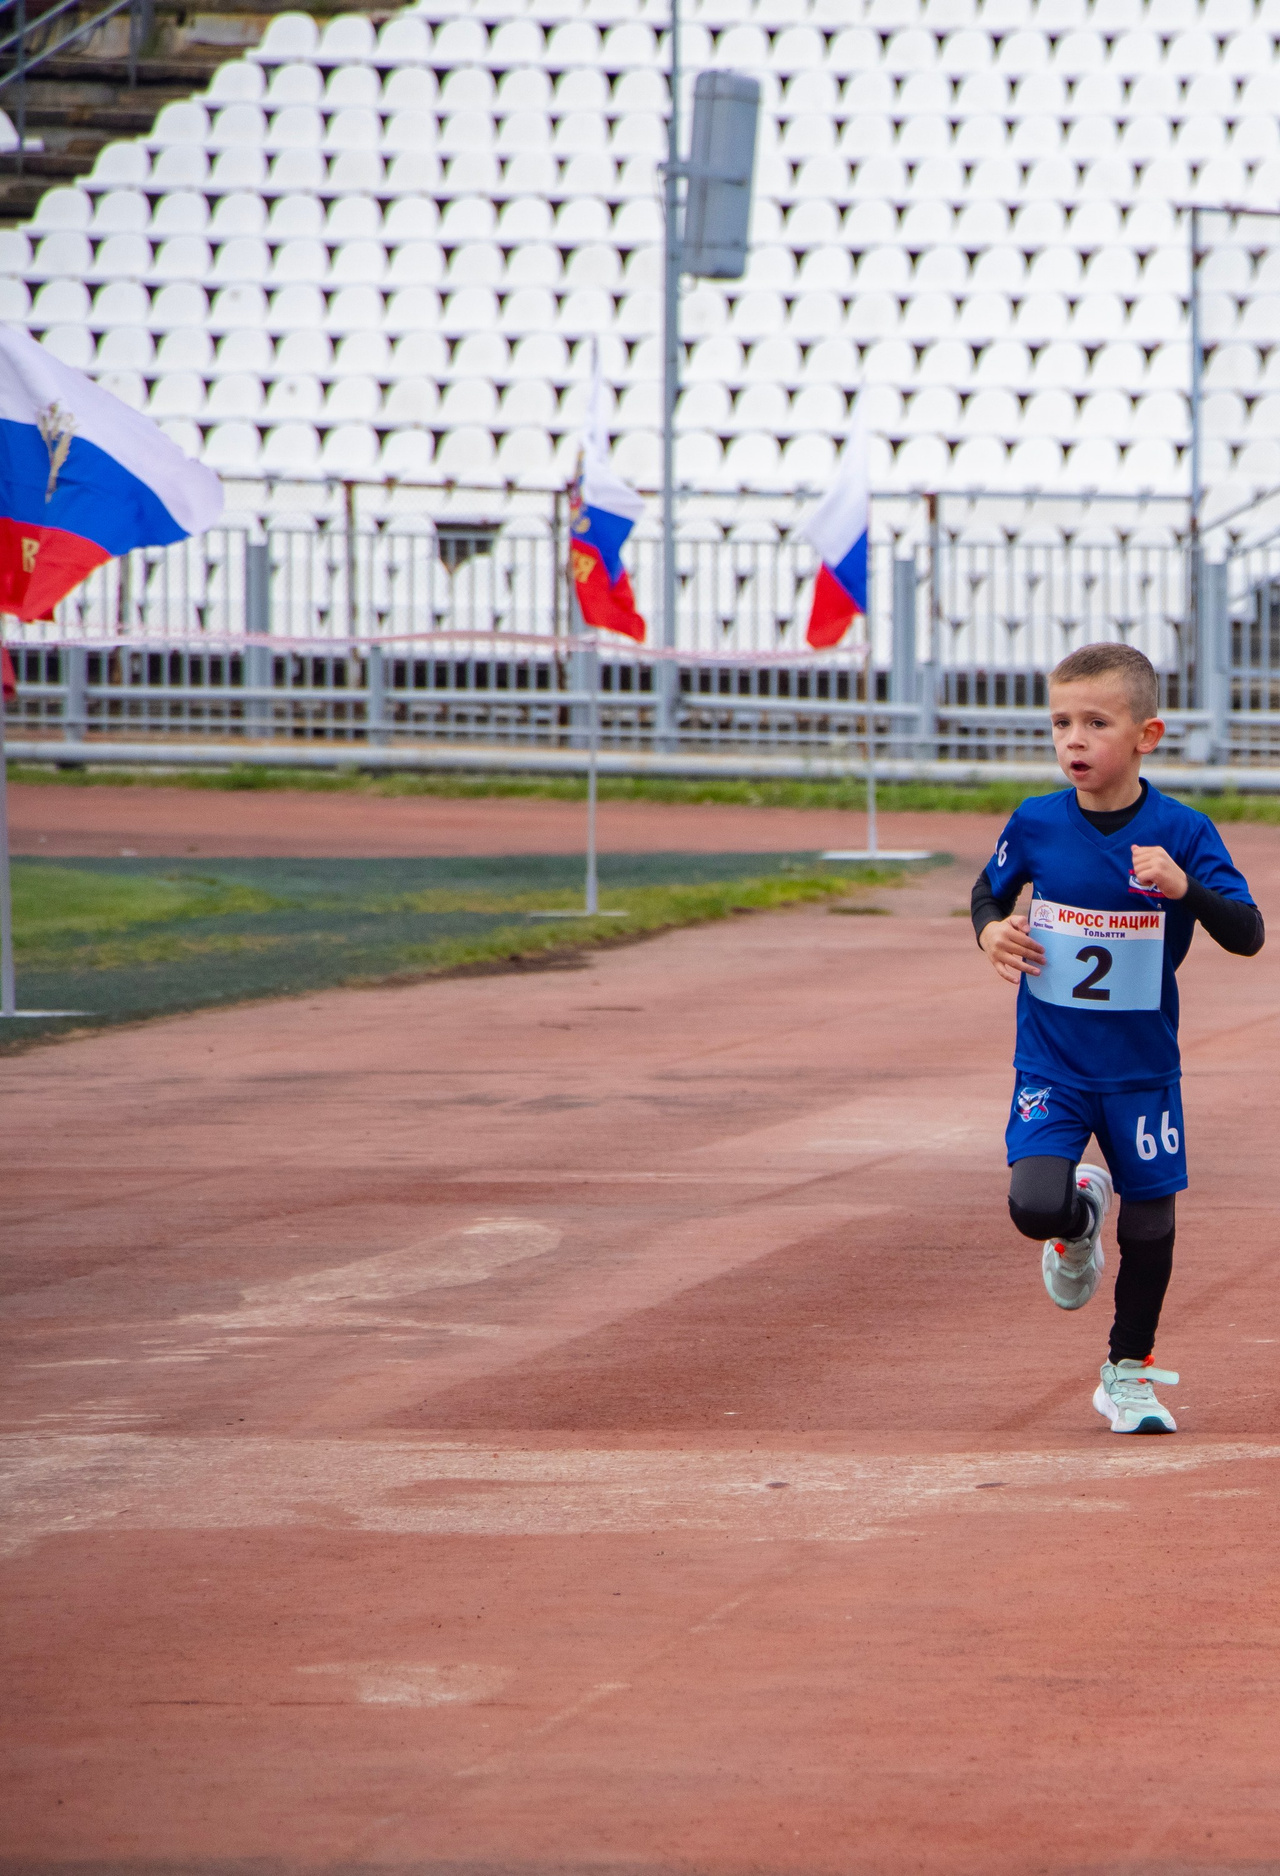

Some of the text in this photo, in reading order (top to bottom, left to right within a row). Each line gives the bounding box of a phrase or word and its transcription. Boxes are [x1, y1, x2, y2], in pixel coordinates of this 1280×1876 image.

[1058, 908, 1104, 928] КРОСС
[1109, 915, 1160, 930] НАЦИИ
[1083, 927, 1126, 938] Тольятти
[1072, 945, 1113, 1001] 2
[1136, 1110, 1179, 1160] 66
